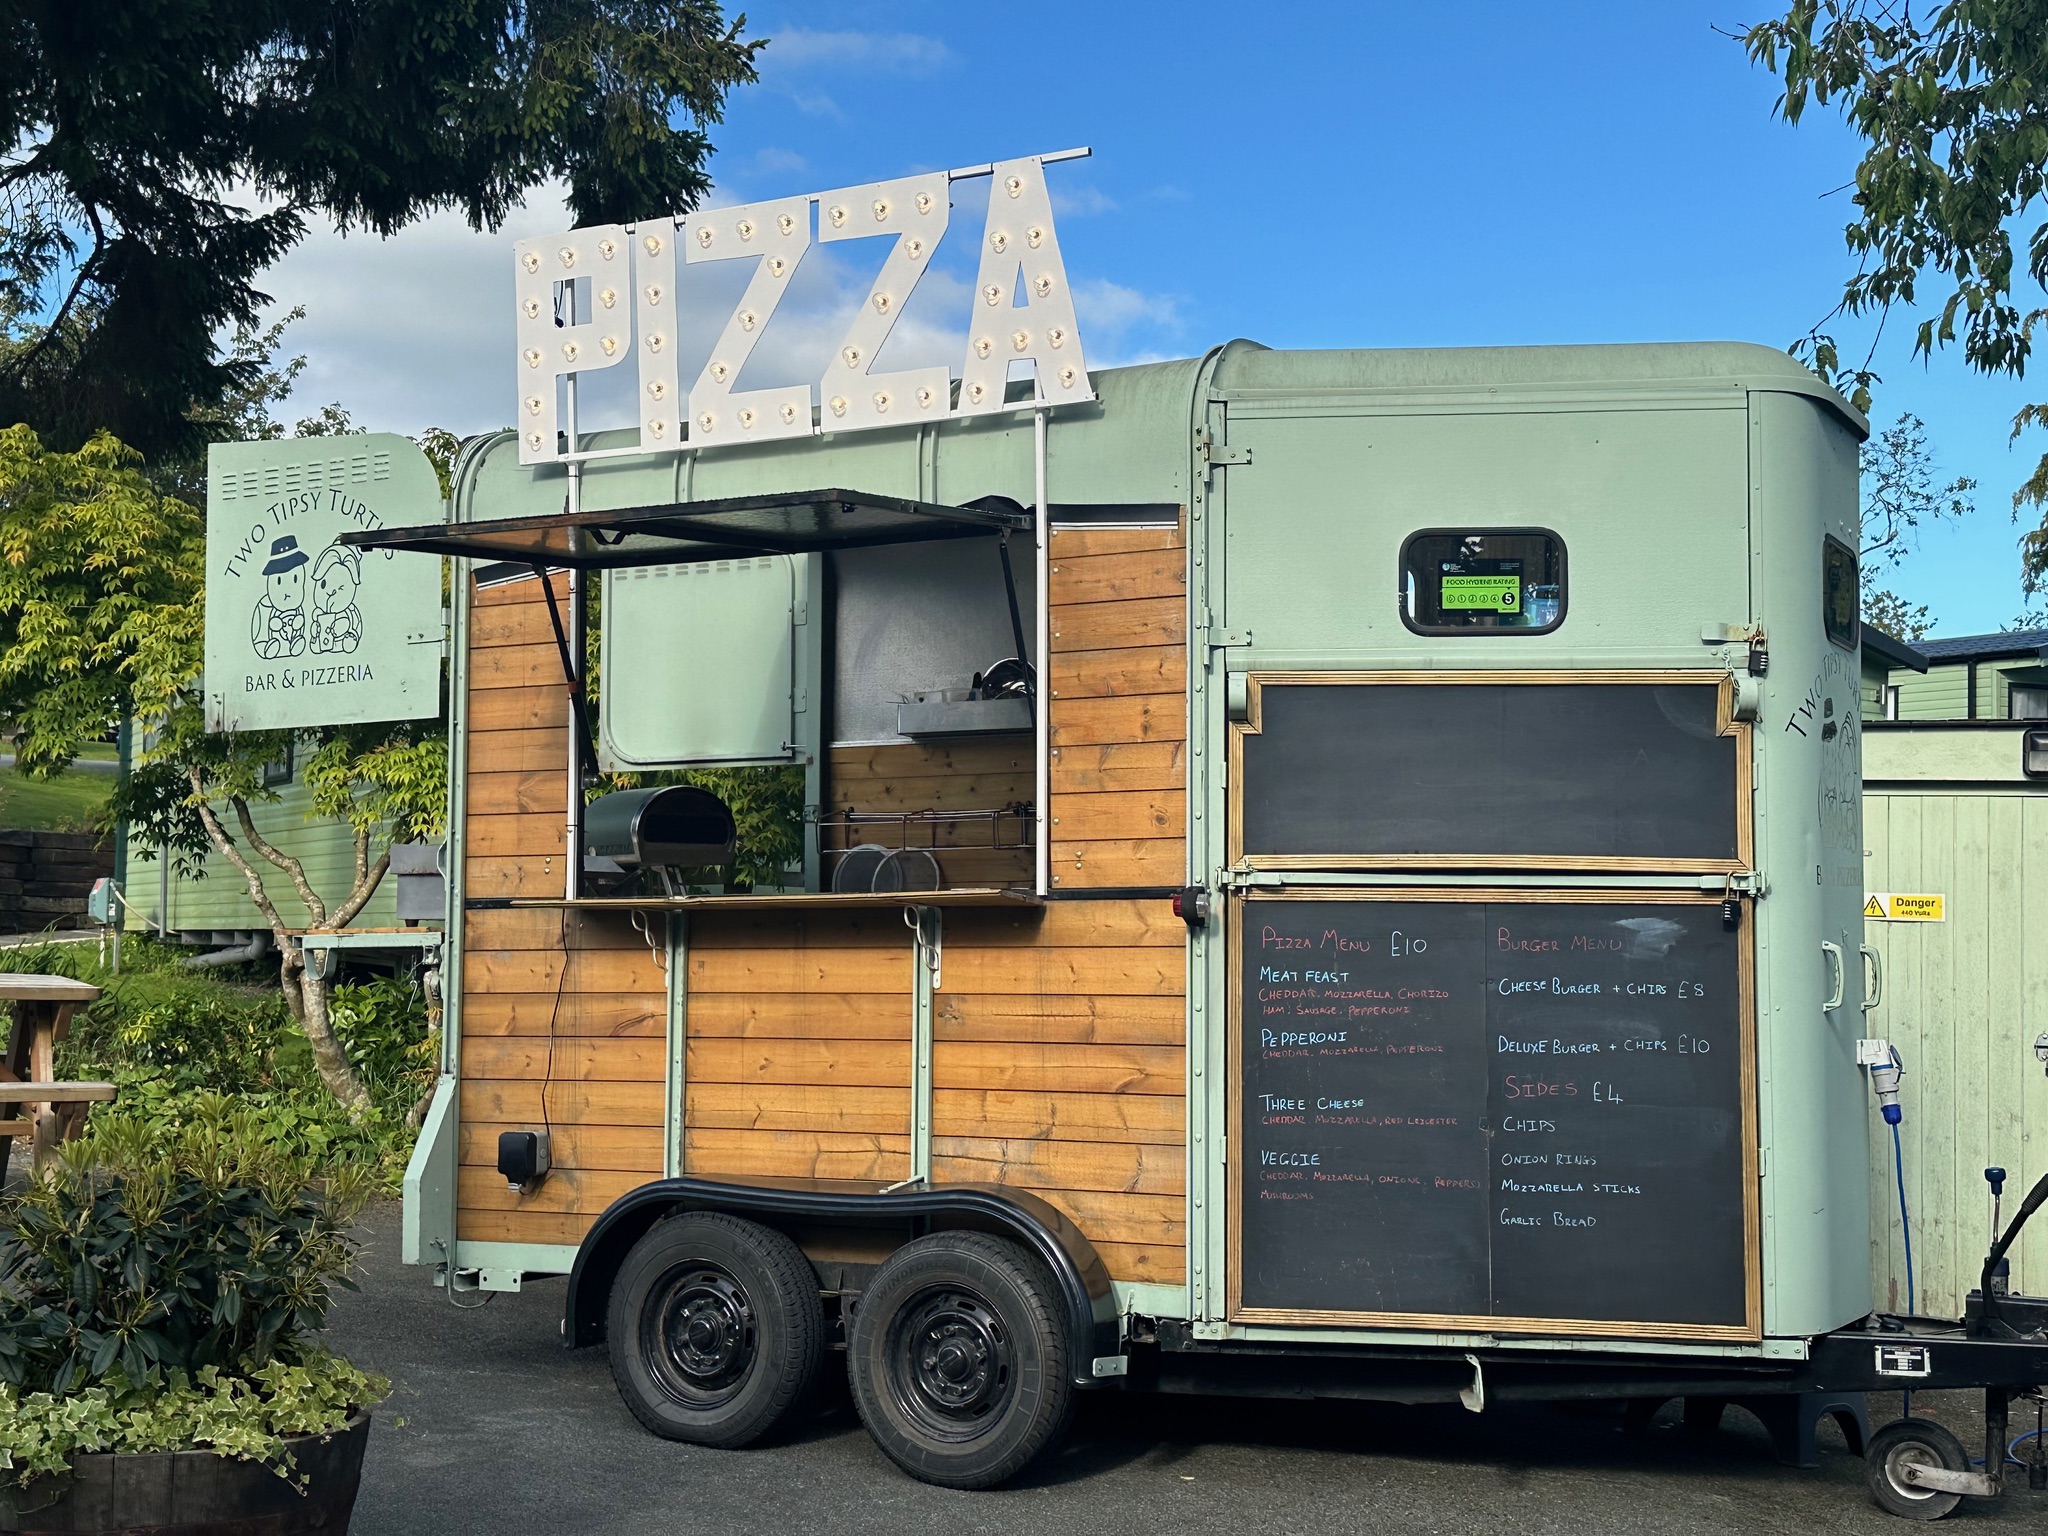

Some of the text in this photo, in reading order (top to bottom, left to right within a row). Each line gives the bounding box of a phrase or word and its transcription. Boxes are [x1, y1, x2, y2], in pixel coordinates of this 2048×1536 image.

[513, 157, 1091, 465] PIZZA
[224, 524, 265, 578] TWO
[266, 491, 321, 525] TIPSY
[1505, 593, 1513, 604] 5
[245, 663, 374, 692] BAR & PIZZERIA
[1785, 675, 1822, 737] TWO
[1896, 897, 1936, 909] Danger
[1262, 926, 1311, 950] PIZZA
[1320, 929, 1371, 952] MENU
[1498, 927, 1622, 952] BURGER MENU
[1260, 966, 1349, 983] MEAT FEAST
[1398, 988, 1449, 1000] CHORIZO
[1498, 978, 1547, 995] CHEESE
[1552, 977, 1601, 995] BURGER
[1612, 984, 1620, 993] +
[1626, 983, 1667, 995] CHIPS
[1261, 1028, 1347, 1047] PEPPERONI
[1498, 1035, 1548, 1054] DELUXE
[1553, 1038, 1600, 1054] BURGER
[1609, 1043, 1617, 1051] +
[1623, 1039, 1667, 1052] CHIPS
[1505, 1075, 1578, 1099] SIDES
[1259, 1094, 1364, 1112] THREE CHEESE
[1503, 1117, 1556, 1133] CHIPS
[1261, 1150, 1321, 1166] VEGGIE
[1502, 1153, 1597, 1166] ONION RINGS
[1501, 1179, 1641, 1195] MOZZARELLA STICKS
[1500, 1208, 1597, 1228] GARLIC BREAD
